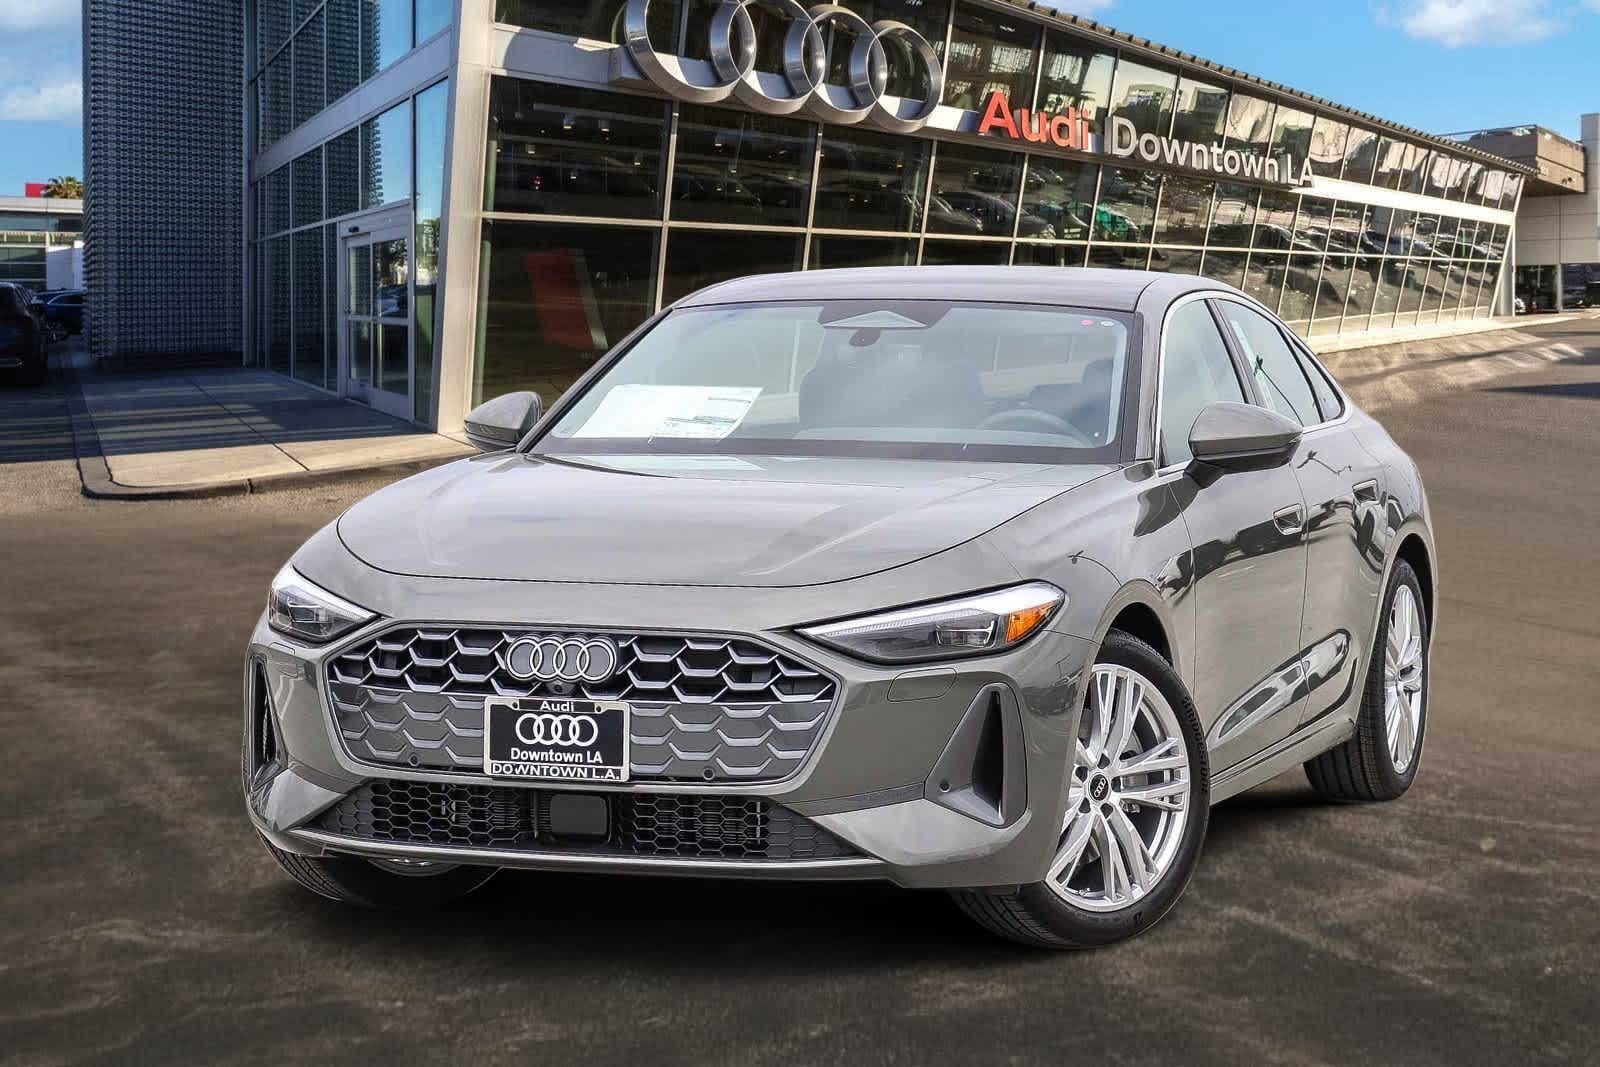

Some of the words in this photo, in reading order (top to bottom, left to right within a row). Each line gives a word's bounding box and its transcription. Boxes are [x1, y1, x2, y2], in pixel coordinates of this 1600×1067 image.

[978, 90, 1089, 151] Audi
[1104, 115, 1280, 181] Downtown
[1282, 157, 1315, 189] LA
[540, 701, 574, 712] Audi
[510, 748, 583, 763] Downtown
[587, 751, 603, 764] LA
[492, 763, 588, 778] DOWNTOWN
[592, 768, 620, 780] L.A.
